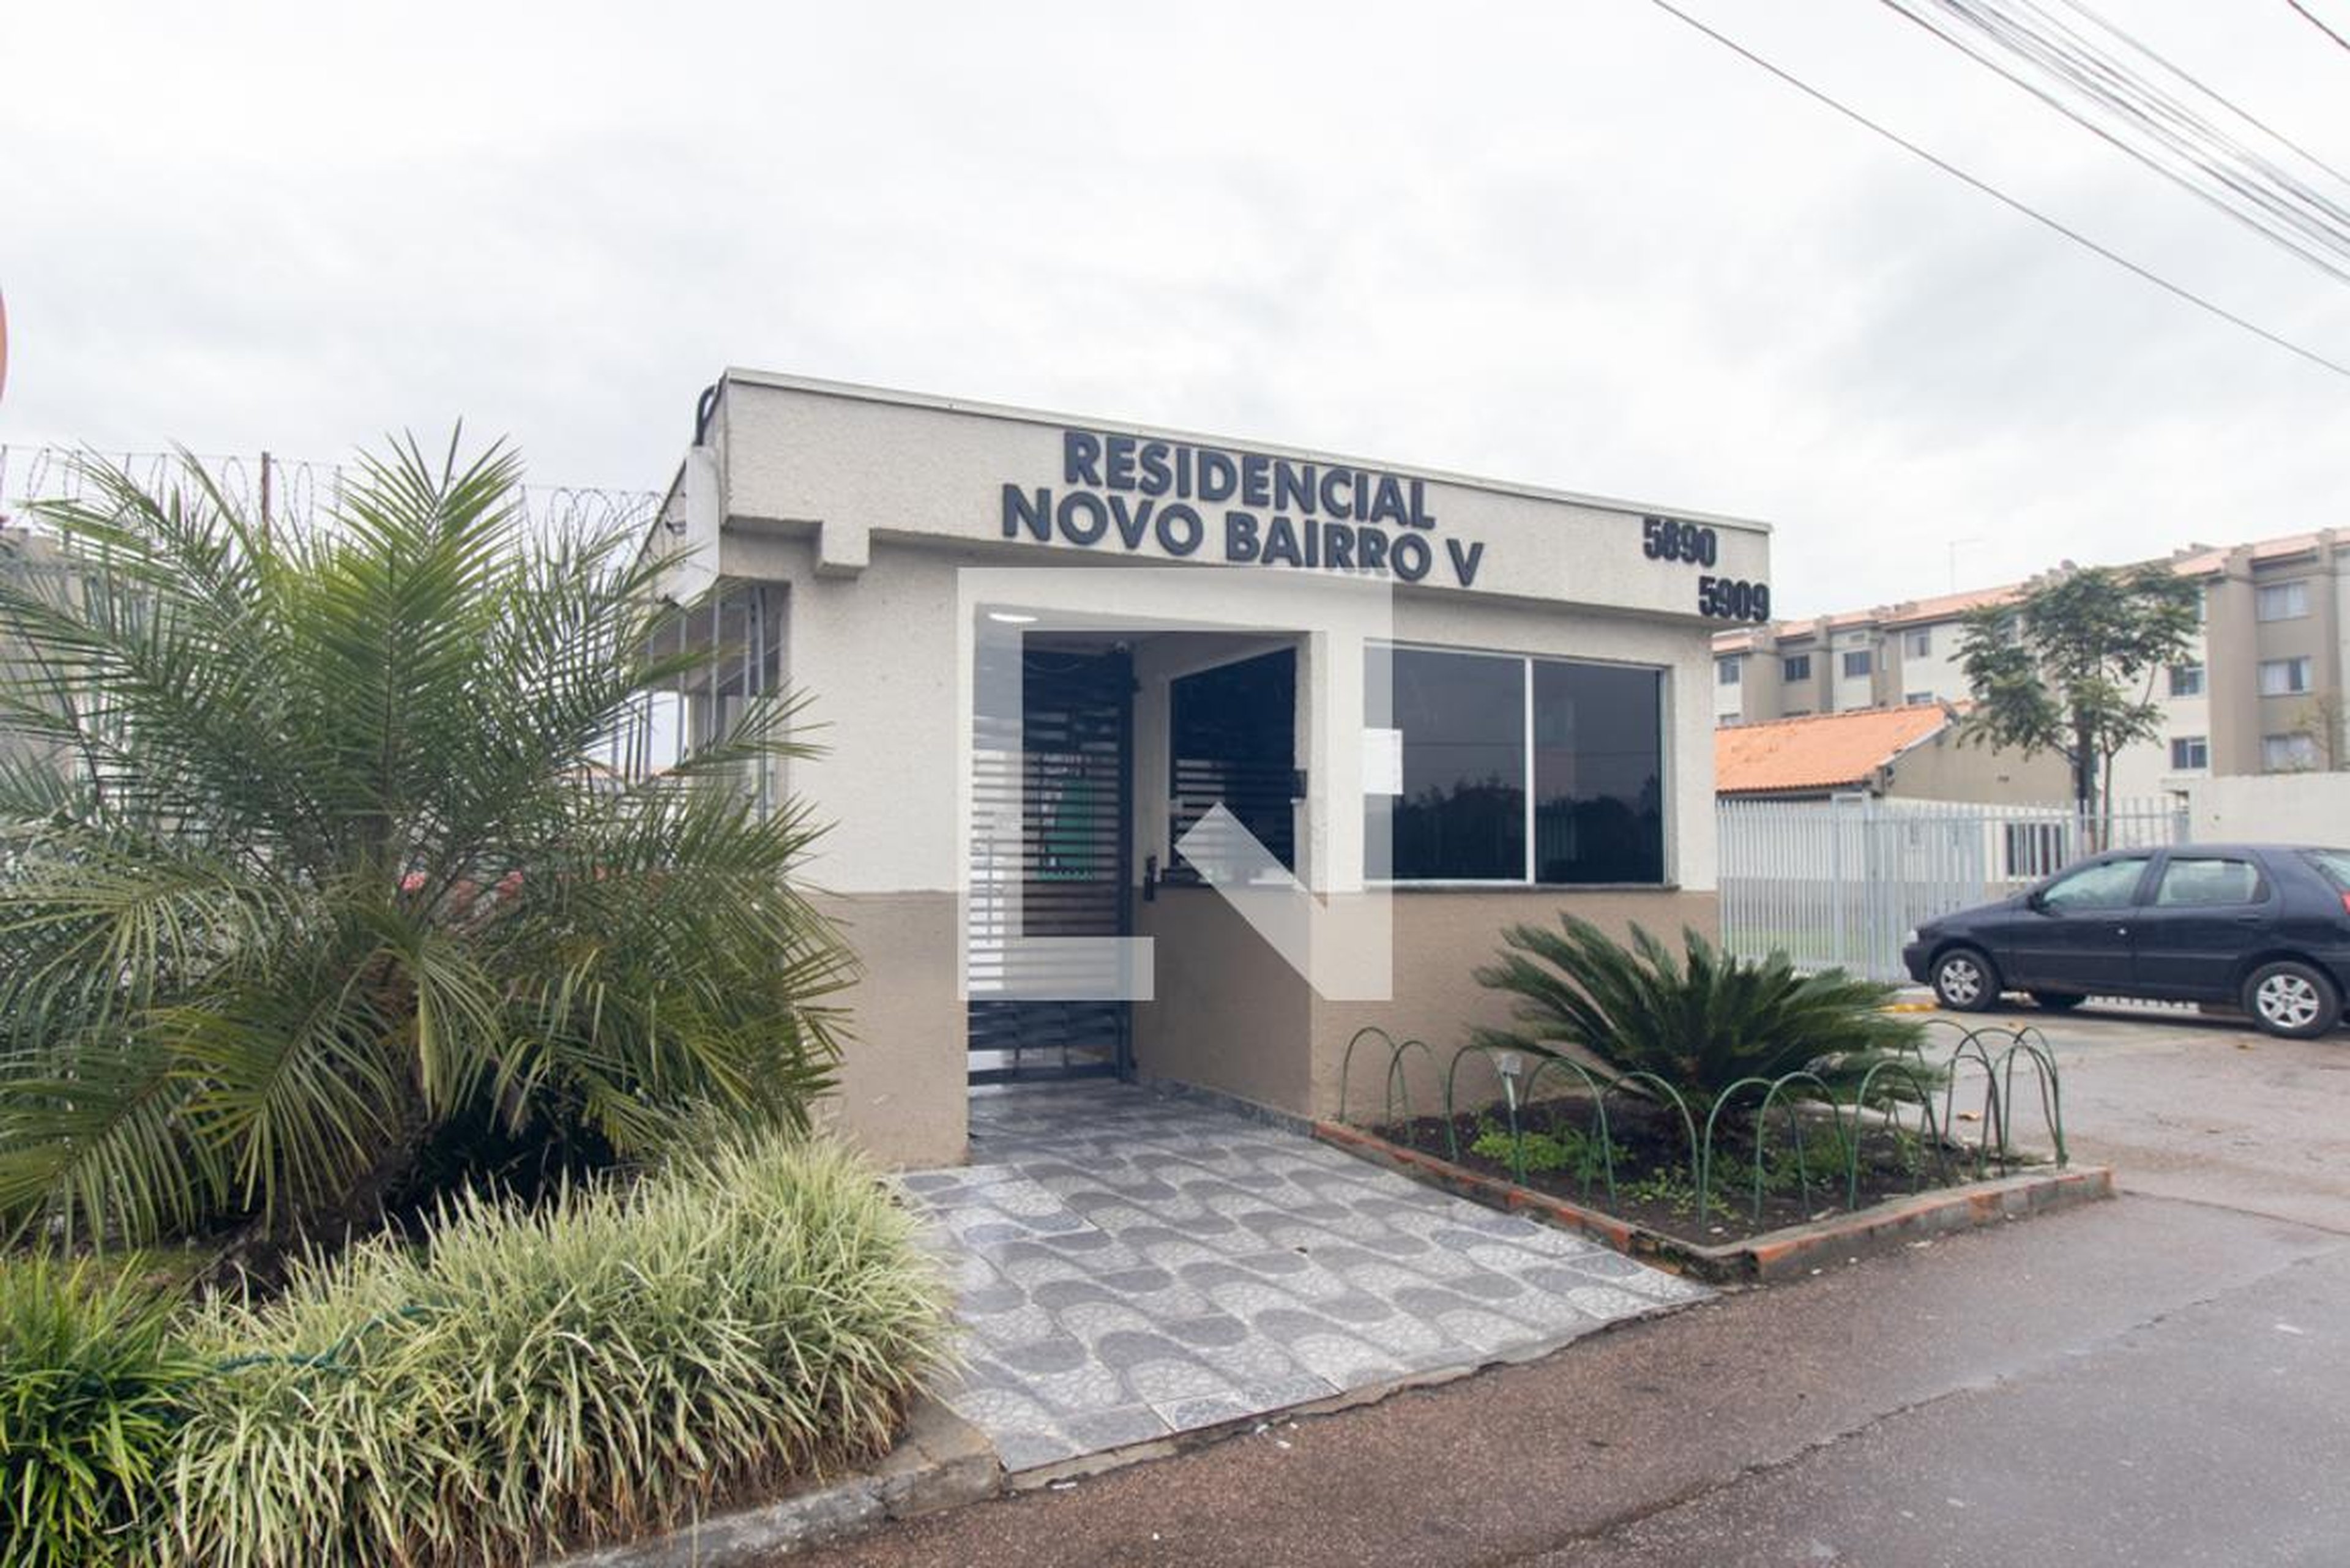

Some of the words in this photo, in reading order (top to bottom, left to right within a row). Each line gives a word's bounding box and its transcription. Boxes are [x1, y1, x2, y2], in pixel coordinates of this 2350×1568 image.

[1064, 430, 1436, 529] RESIDENCIAL
[1002, 483, 1204, 556] NOVO
[1225, 511, 1432, 582] BAIRRO
[1447, 539, 1484, 586] V
[1698, 575, 1770, 622] 5909
